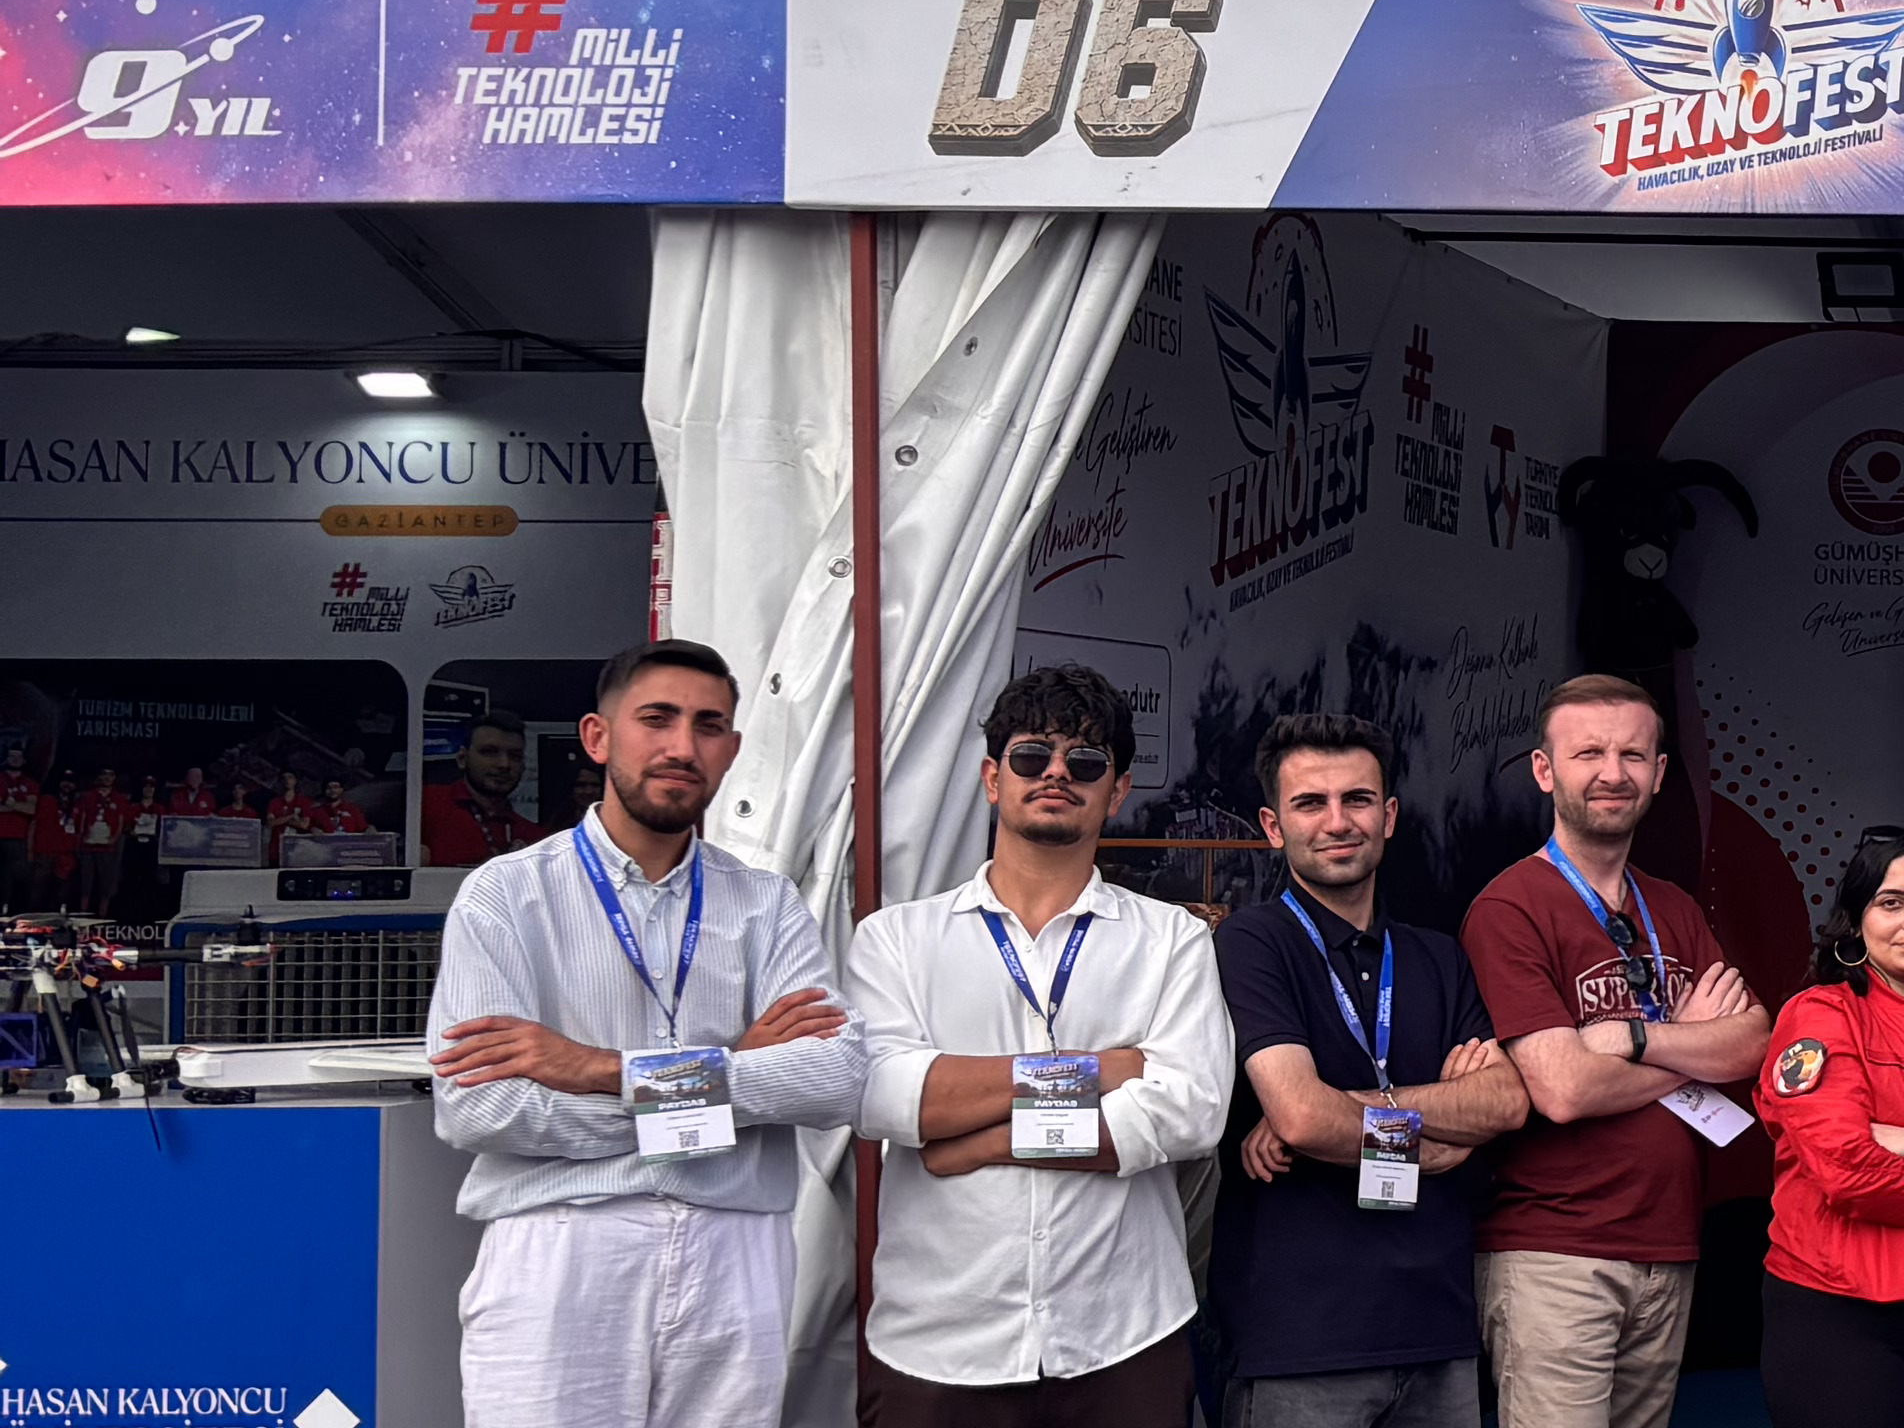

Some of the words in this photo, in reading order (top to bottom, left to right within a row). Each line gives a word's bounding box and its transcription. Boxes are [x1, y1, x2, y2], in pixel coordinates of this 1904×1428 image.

[1706, 159, 1737, 178] UZAY
[1739, 155, 1755, 170] VE
[171, 438, 477, 484] KALYONCU
[1209, 410, 1377, 587] TEKNOFEST
[2, 1388, 108, 1416] HASAN
[118, 1387, 287, 1415] KALYONCU
